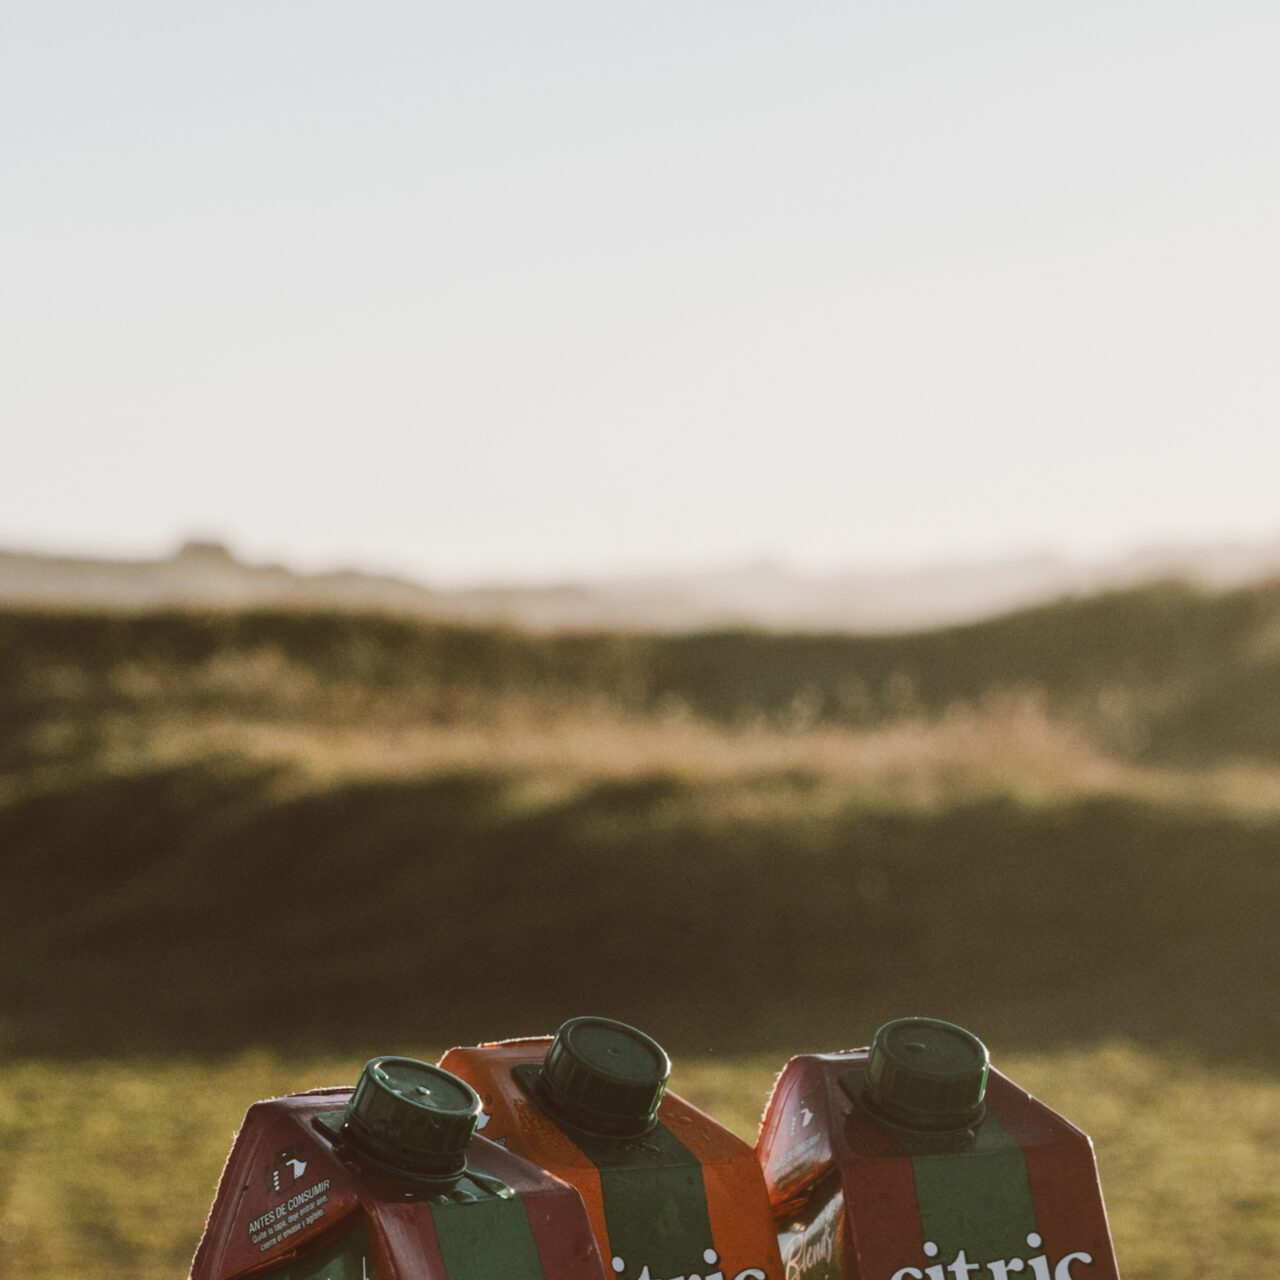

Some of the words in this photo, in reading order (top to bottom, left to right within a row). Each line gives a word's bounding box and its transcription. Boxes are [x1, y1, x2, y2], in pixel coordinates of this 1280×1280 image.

[249, 1211, 275, 1234] ANTES
[276, 1203, 286, 1218] DE
[288, 1179, 330, 1211] CONSUMIR
